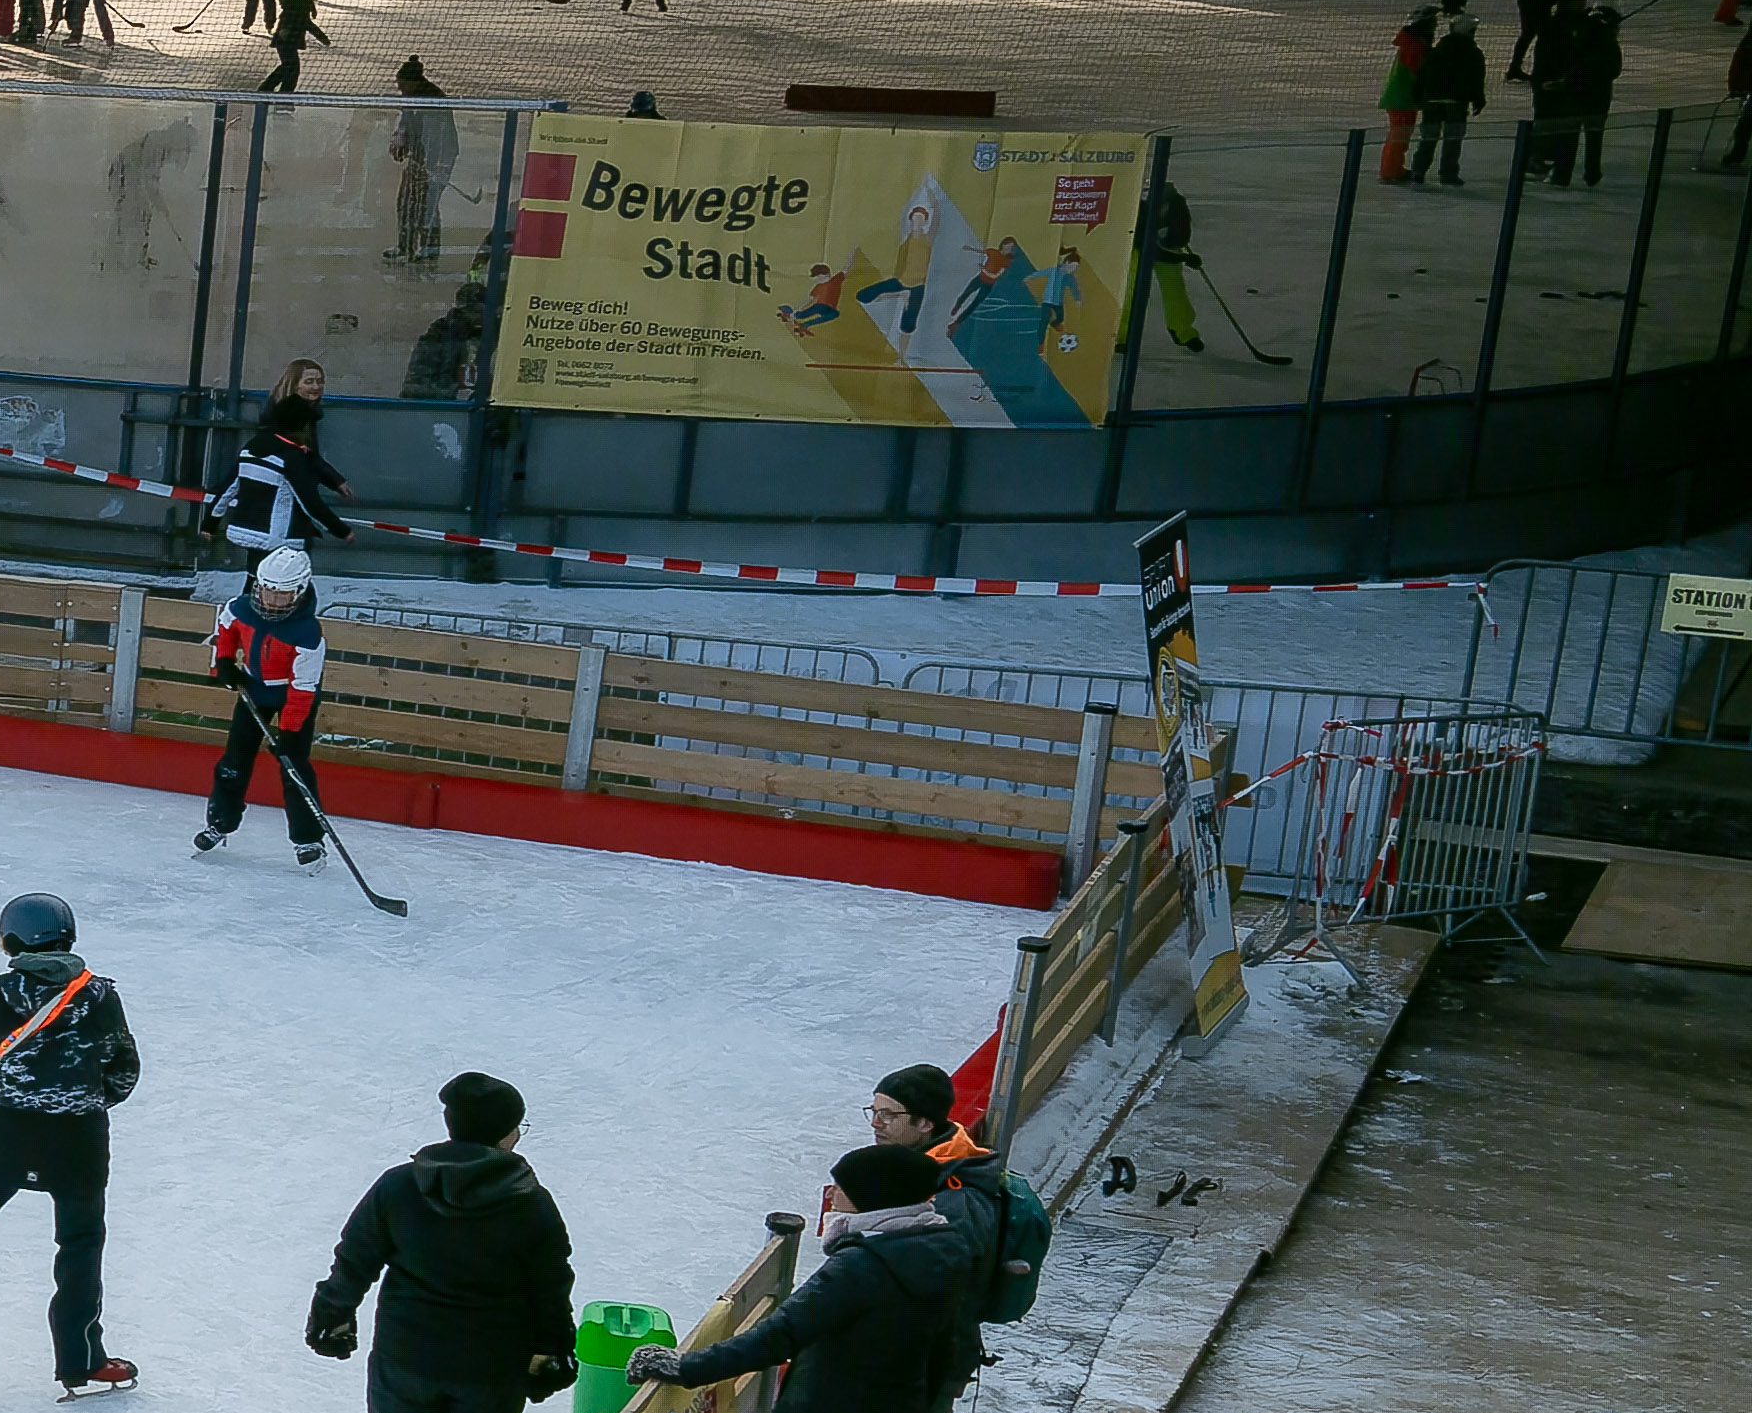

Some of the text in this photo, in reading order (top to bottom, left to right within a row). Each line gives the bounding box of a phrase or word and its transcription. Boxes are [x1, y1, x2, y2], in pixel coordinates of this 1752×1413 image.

[1000, 150, 1048, 163] STADT
[1059, 150, 1135, 163] SALZBURG
[581, 159, 809, 232] Bewegte
[642, 236, 771, 294] Stadt
[528, 295, 629, 316] Beweg dich!
[525, 314, 745, 344] Nutze über 60 Bewegungs-
[521, 333, 767, 362] Angebote der Stadt im Freien.
[1671, 587, 1746, 610] STATION
